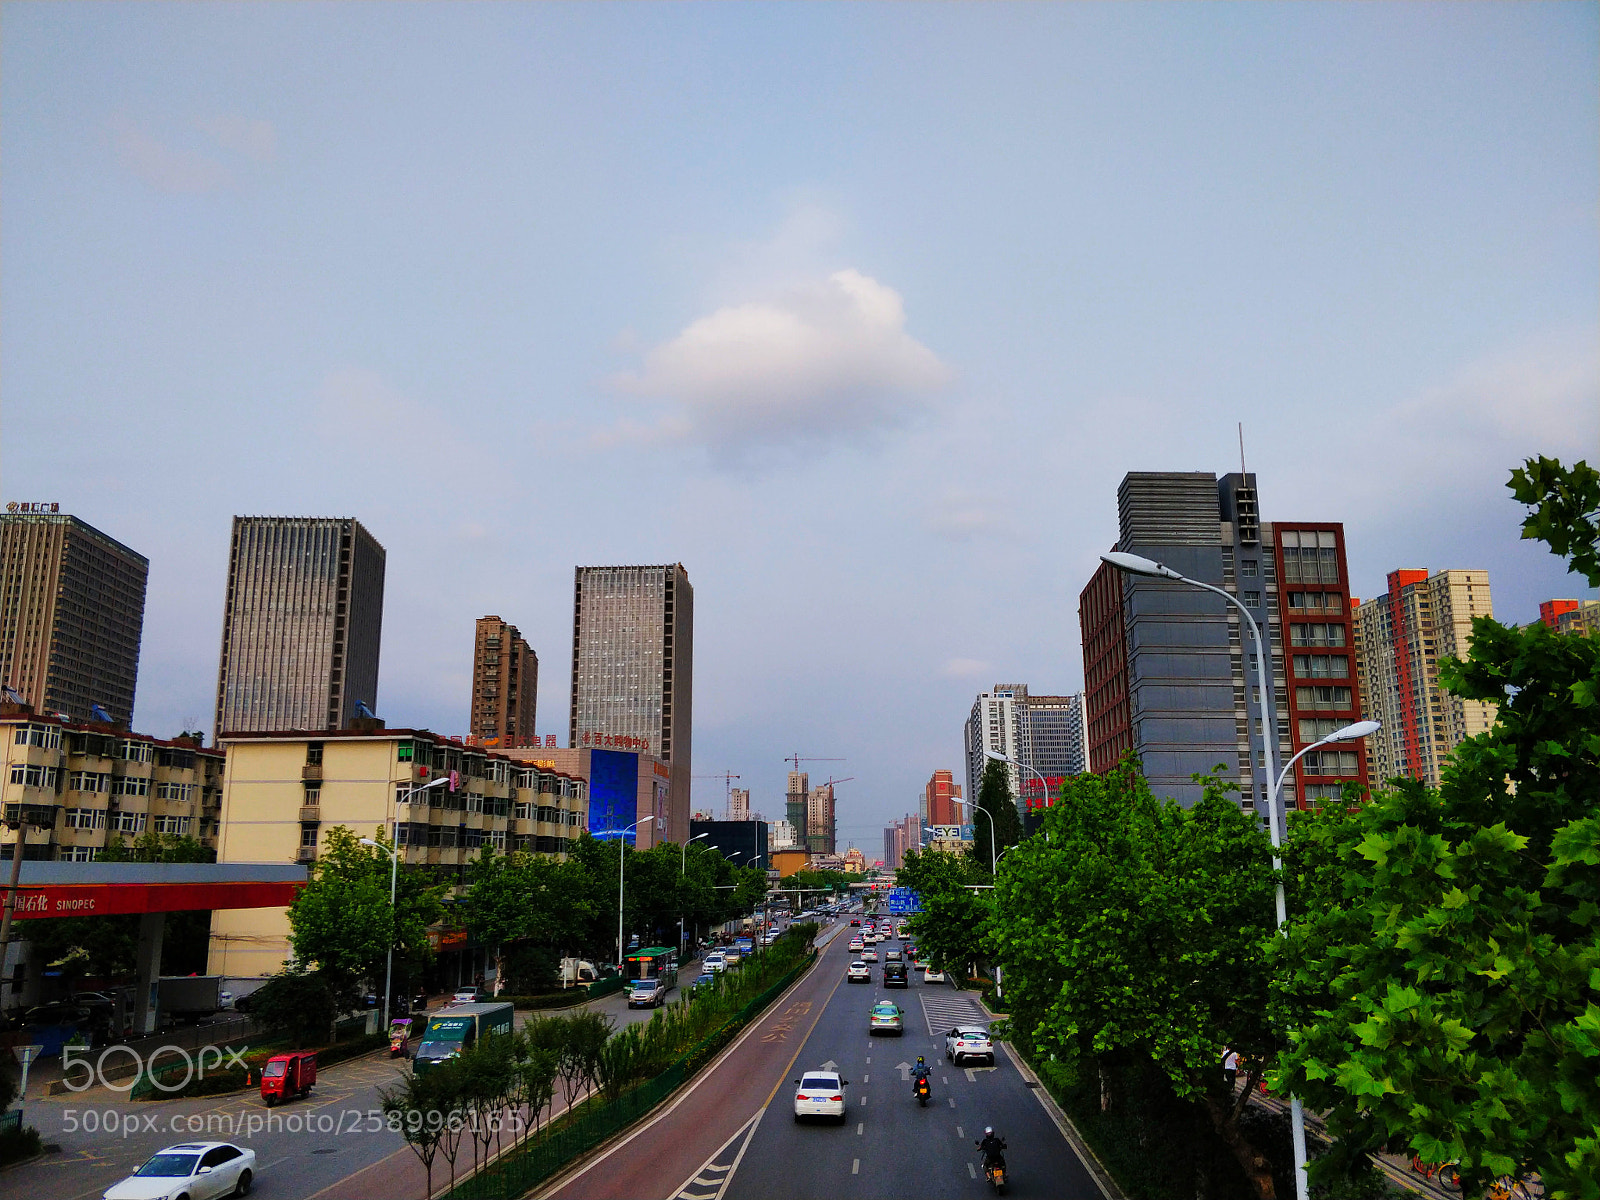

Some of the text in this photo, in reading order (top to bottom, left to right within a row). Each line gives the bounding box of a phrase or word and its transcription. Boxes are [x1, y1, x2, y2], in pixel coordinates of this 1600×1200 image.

[593, 732, 650, 750] 百大购物中心
[56, 899, 95, 911] SINOPEC
